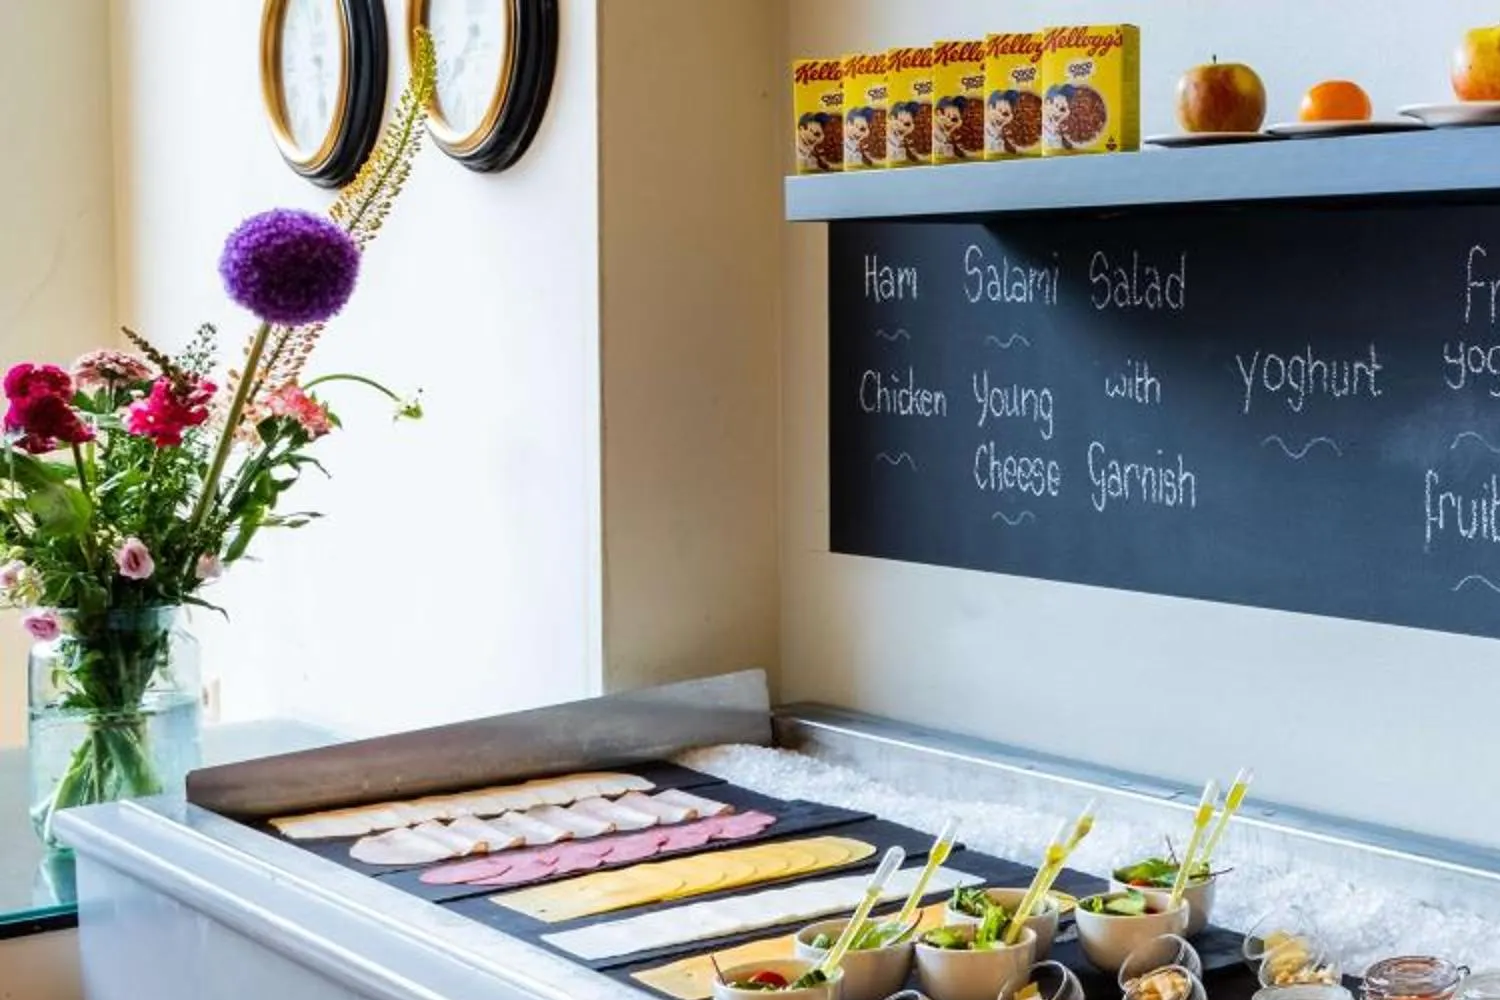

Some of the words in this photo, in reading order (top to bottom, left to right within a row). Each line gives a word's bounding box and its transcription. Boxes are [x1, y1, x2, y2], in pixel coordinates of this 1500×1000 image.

[1044, 25, 1122, 56] Kellogg's
[864, 253, 918, 303] Ham
[964, 244, 1059, 306] Salami
[1089, 250, 1186, 310] Salad
[859, 368, 947, 418] Chicken
[1105, 358, 1162, 404] with
[974, 441, 1061, 498] Cheese
